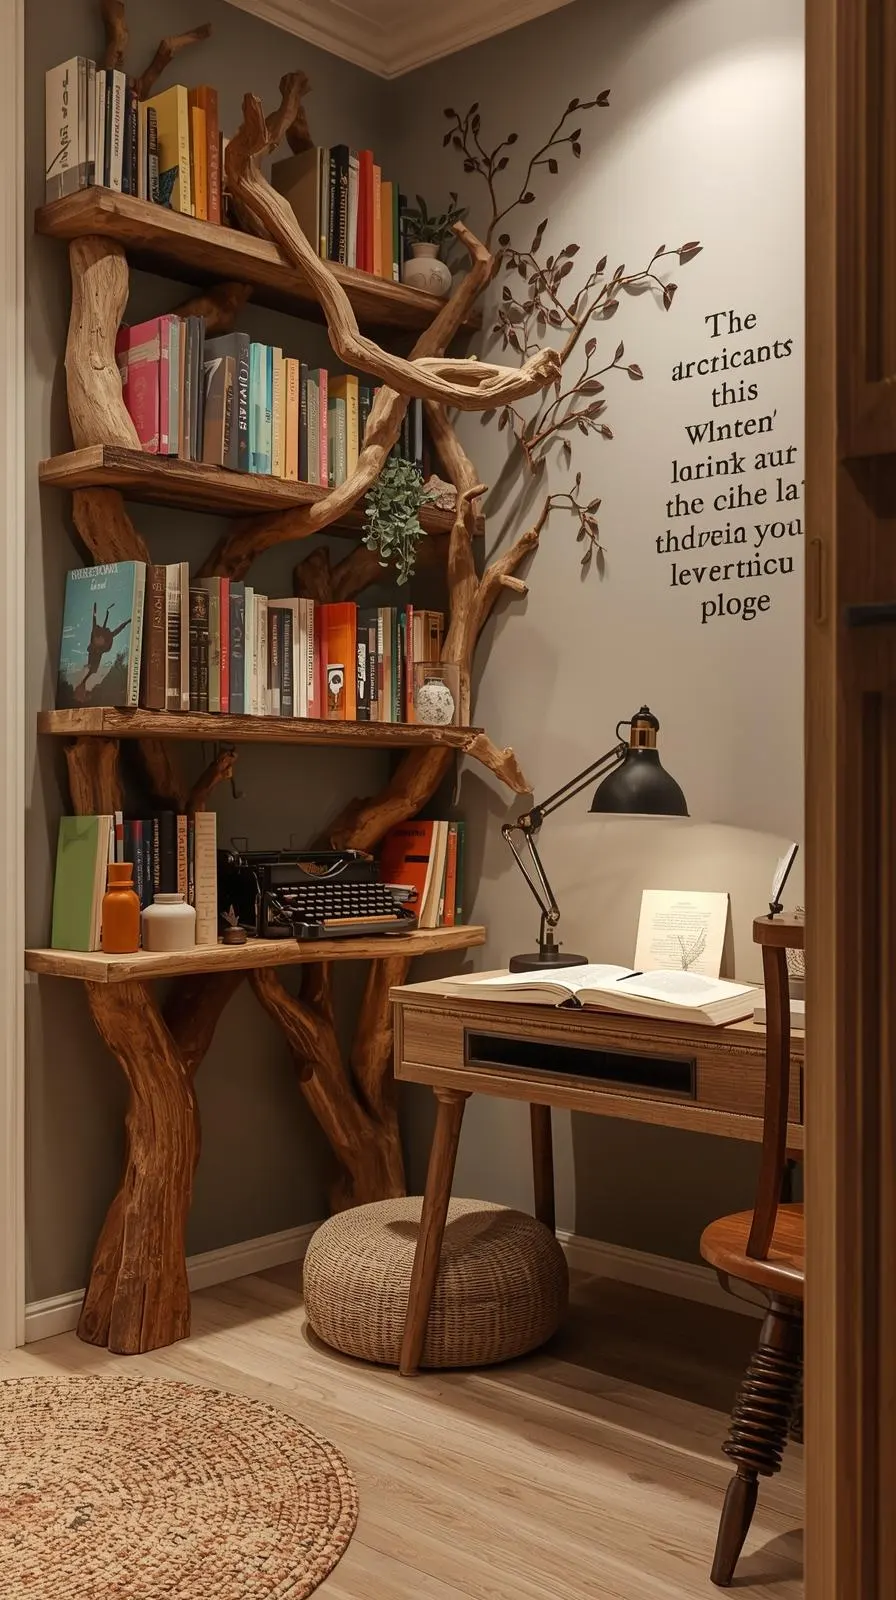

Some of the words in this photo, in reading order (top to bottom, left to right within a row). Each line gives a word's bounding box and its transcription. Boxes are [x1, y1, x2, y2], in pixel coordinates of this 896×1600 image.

[705, 309, 757, 338] The
[711, 380, 758, 408] this
[666, 494, 704, 518] the
[713, 484, 768, 511] cihe
[754, 518, 803, 548] you
[701, 593, 771, 624] ploge
